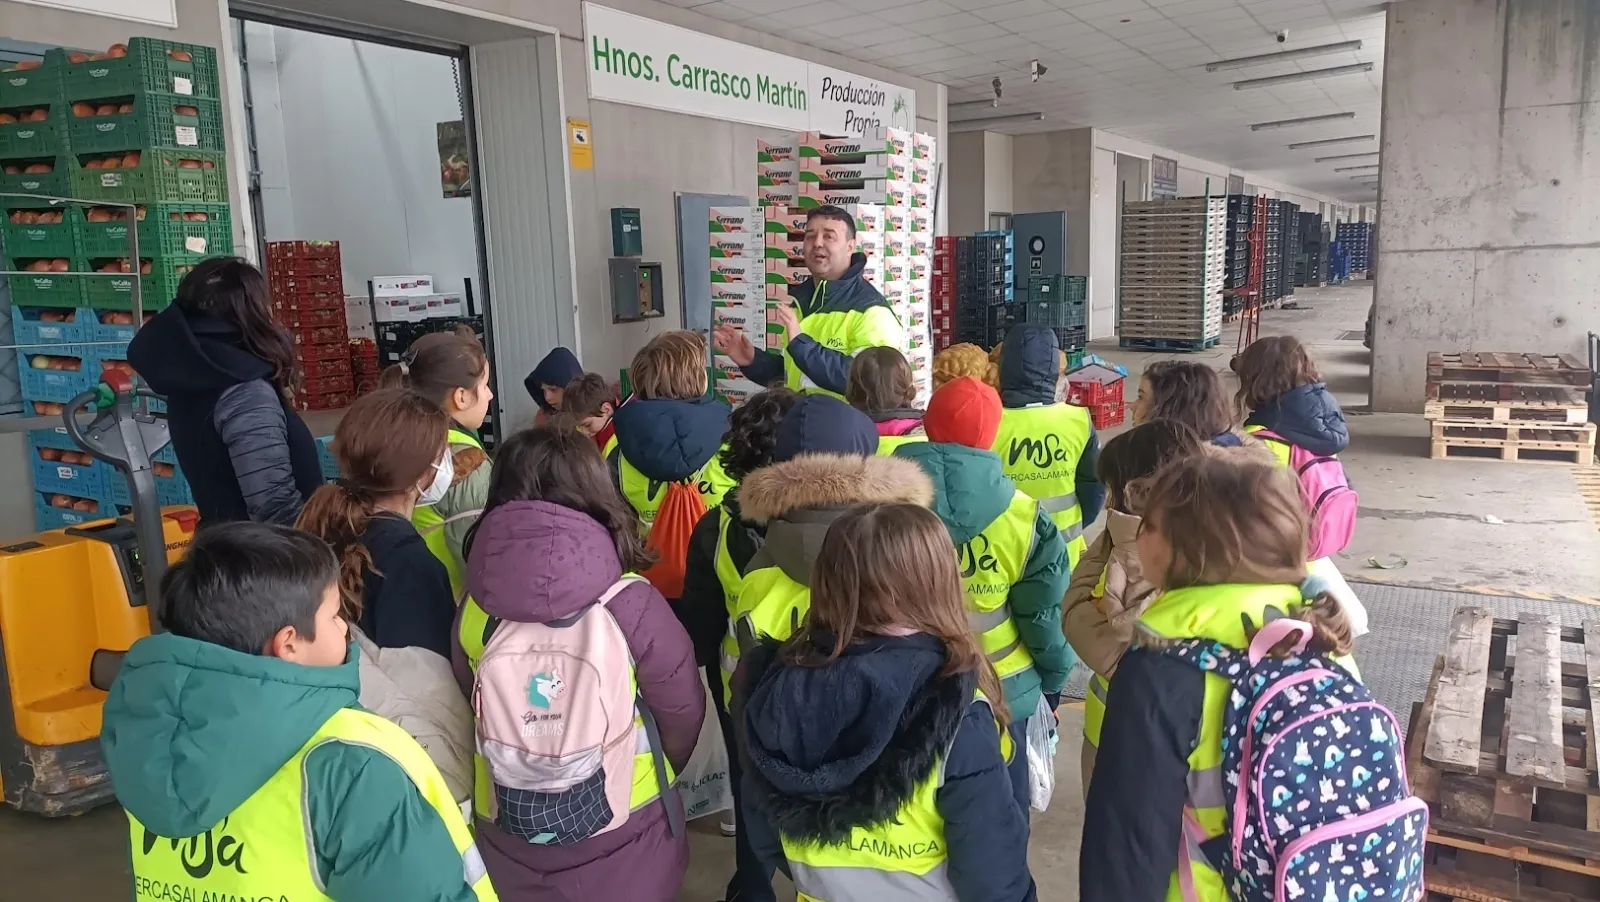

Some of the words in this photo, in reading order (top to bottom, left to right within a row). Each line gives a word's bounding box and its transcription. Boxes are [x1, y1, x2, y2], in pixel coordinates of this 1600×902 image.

[592, 35, 660, 82] Hnos.
[667, 53, 751, 100] Carrasco
[756, 73, 807, 111] Martín
[821, 76, 885, 107] Producción
[844, 109, 881, 138] Propia
[764, 146, 792, 154] Serrano
[824, 144, 861, 153] Serrano
[765, 170, 792, 178] Serrano
[825, 169, 862, 178] Serrano
[765, 193, 792, 201] Serrano
[823, 194, 860, 204] Serrano
[716, 215, 744, 224] Serrano
[716, 241, 744, 249] Serrano
[717, 265, 745, 275] Serrano
[718, 291, 746, 300] Serrano
[719, 315, 746, 325] Serrano
[521, 722, 564, 738] DREAMS
